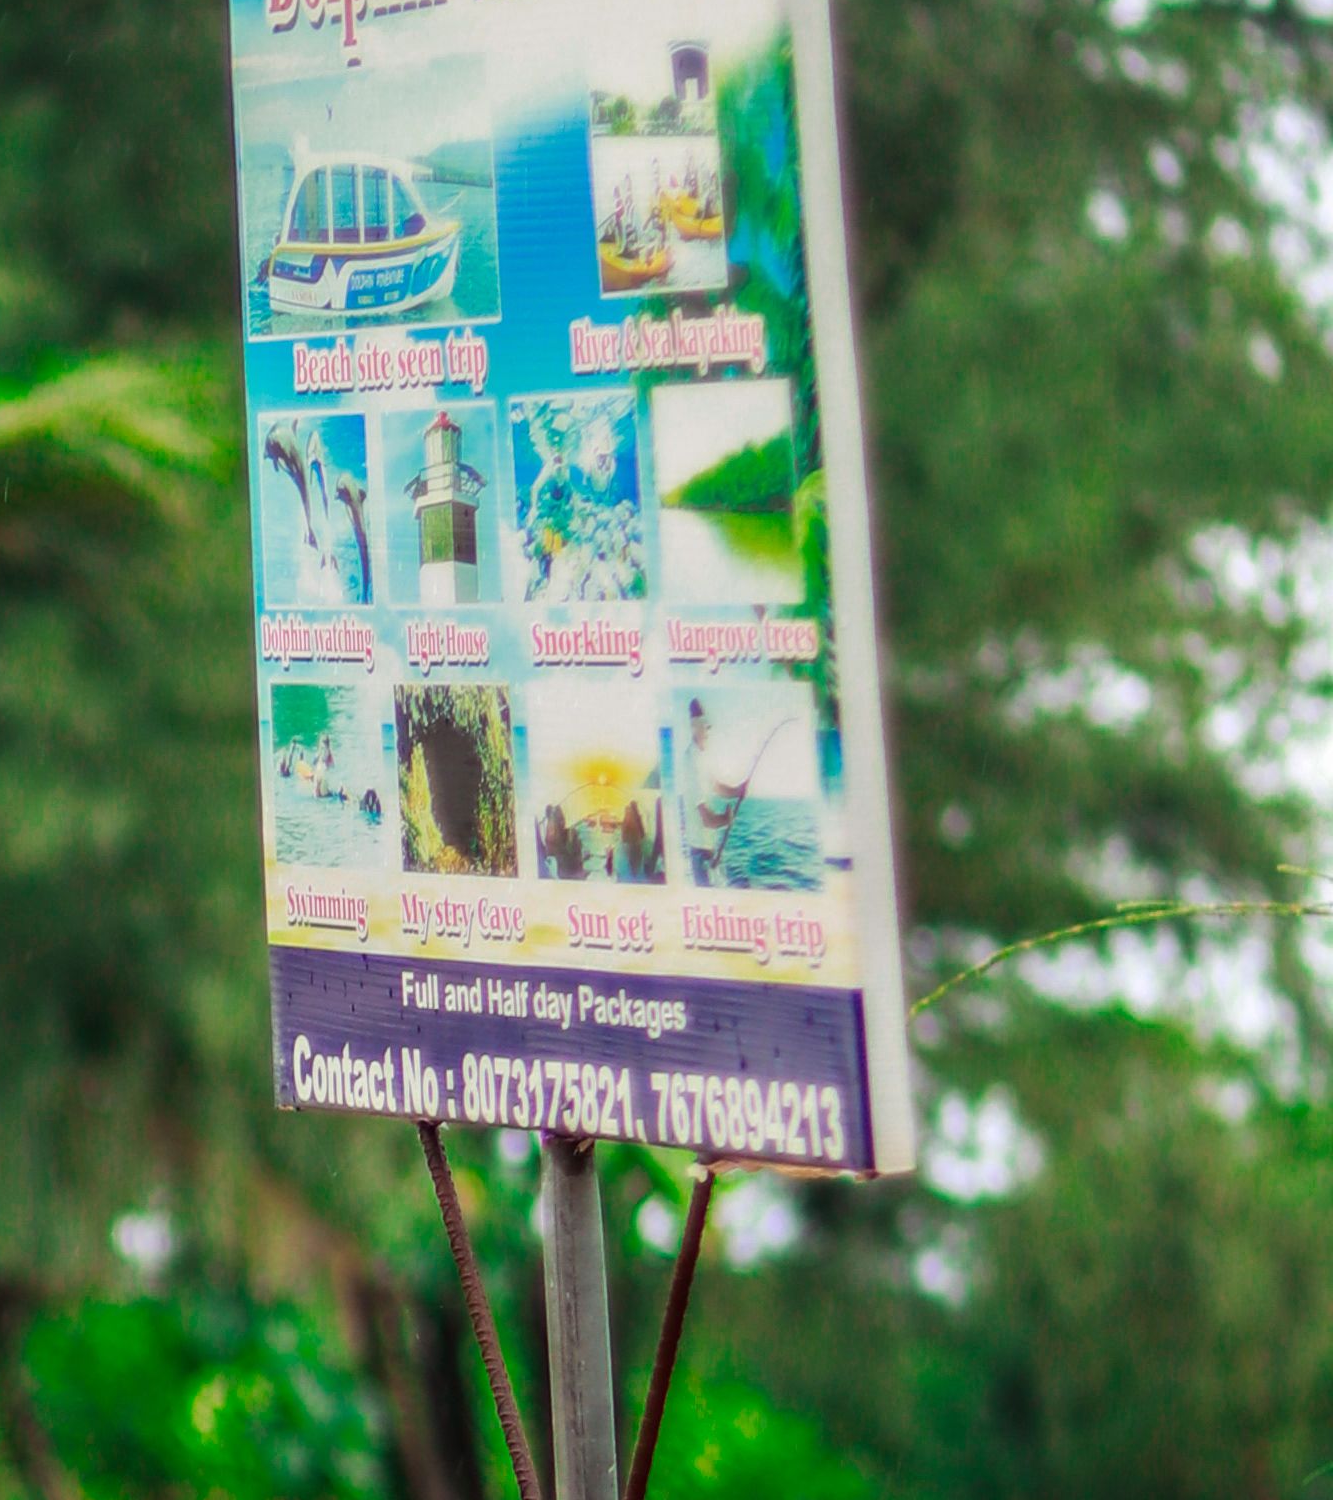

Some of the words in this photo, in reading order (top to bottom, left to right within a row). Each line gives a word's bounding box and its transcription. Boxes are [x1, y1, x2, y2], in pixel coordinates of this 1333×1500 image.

[295, 343, 352, 386] Beach
[357, 342, 391, 382] site
[397, 343, 442, 379] seen
[447, 335, 485, 386] trip
[572, 322, 620, 366] River
[623, 317, 637, 362] &
[262, 617, 311, 662] Dolphin
[314, 621, 373, 662] watching
[406, 622, 443, 662] Light
[445, 624, 487, 657] House
[532, 619, 642, 668] Snorkling
[667, 619, 757, 666] Mangrove
[762, 619, 817, 653] trees
[287, 885, 366, 933] Swimming
[401, 892, 431, 940] My
[435, 897, 473, 942] stry
[477, 896, 524, 932] Cave
[567, 903, 610, 940] Sun
[617, 908, 652, 942] set
[682, 903, 768, 956] Fishing
[774, 910, 823, 958] trip
[401, 971, 440, 1009] Full
[444, 977, 482, 1014] and
[487, 978, 528, 1020] Half
[533, 985, 573, 1030] day
[578, 985, 687, 1039] Packages
[292, 1035, 397, 1114] Contact
[401, 1046, 440, 1117] No
[650, 1071, 846, 1161] 7676894213
